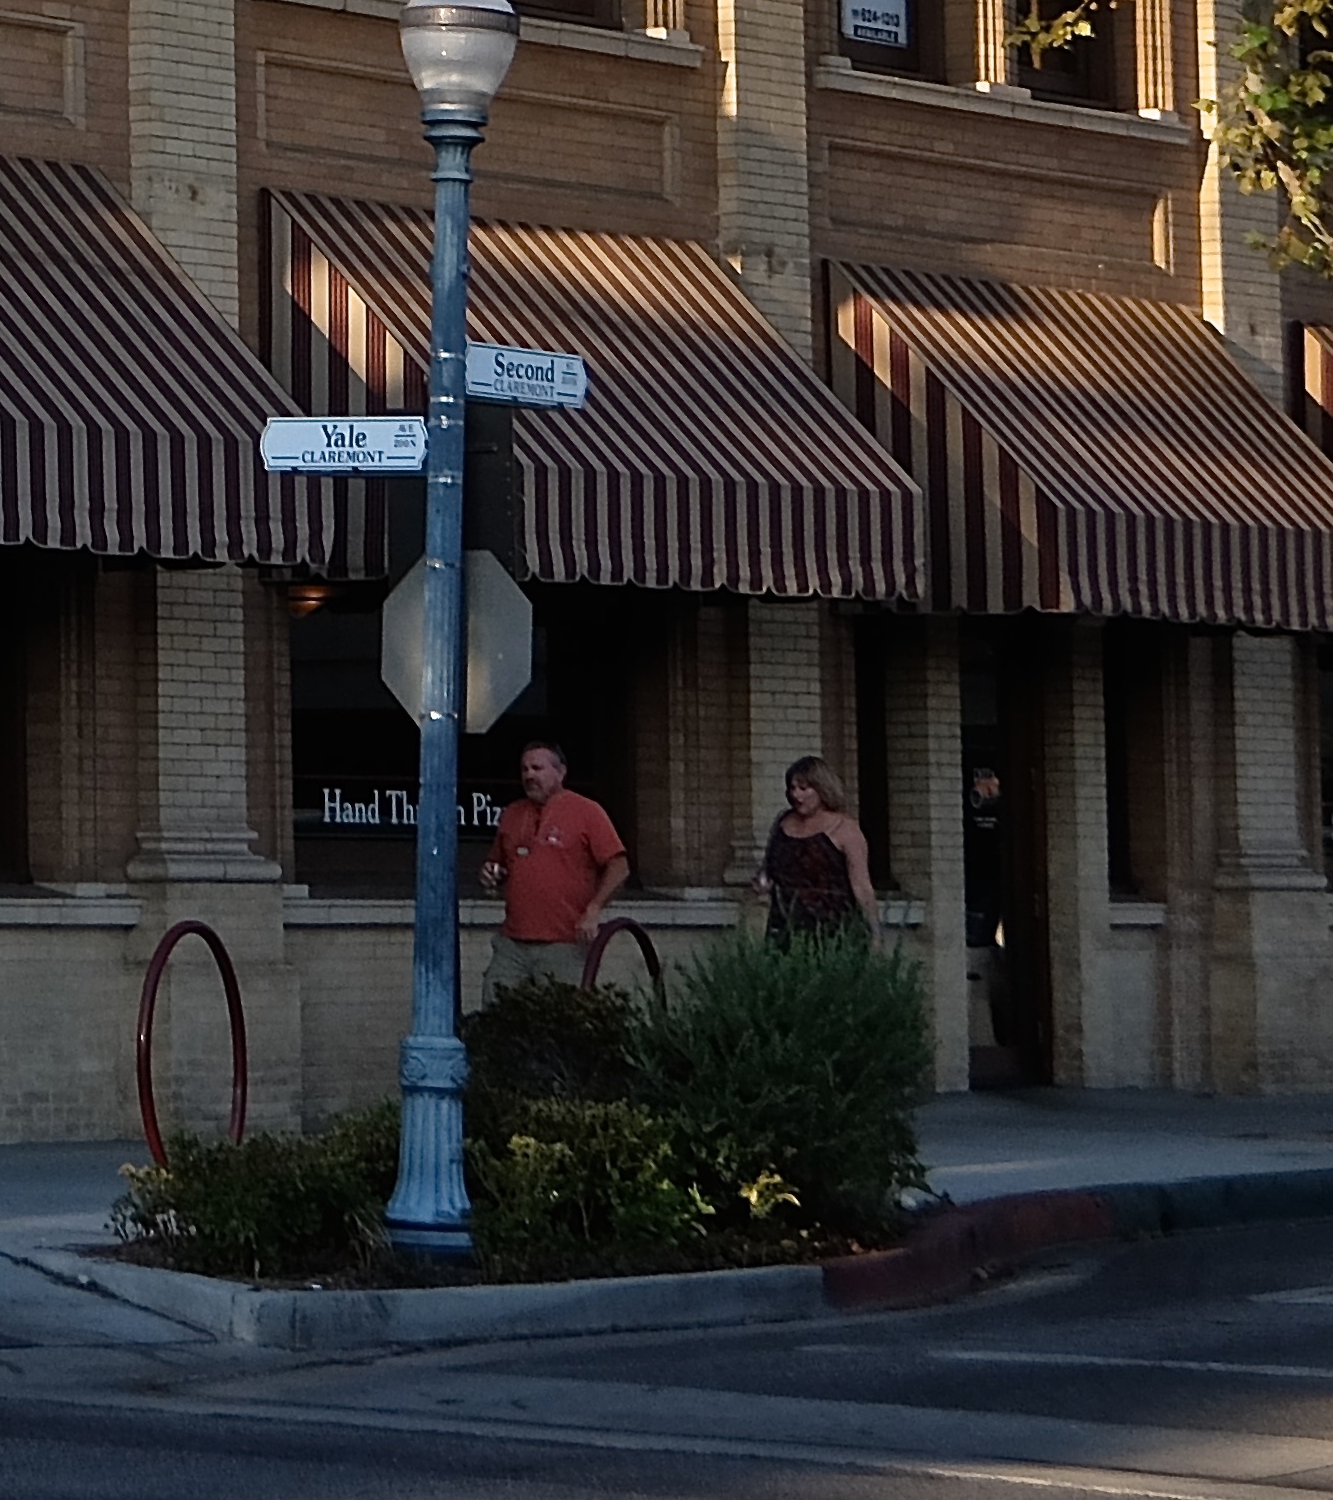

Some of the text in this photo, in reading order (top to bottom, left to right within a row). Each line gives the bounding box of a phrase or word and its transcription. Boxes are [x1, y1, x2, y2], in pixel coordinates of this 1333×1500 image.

[494, 352, 555, 383] Second
[493, 378, 555, 398] CLAREMONT
[321, 424, 367, 448] Yale
[301, 450, 384, 464] CLAREMONT
[322, 788, 507, 826] Hand Thn Piz
